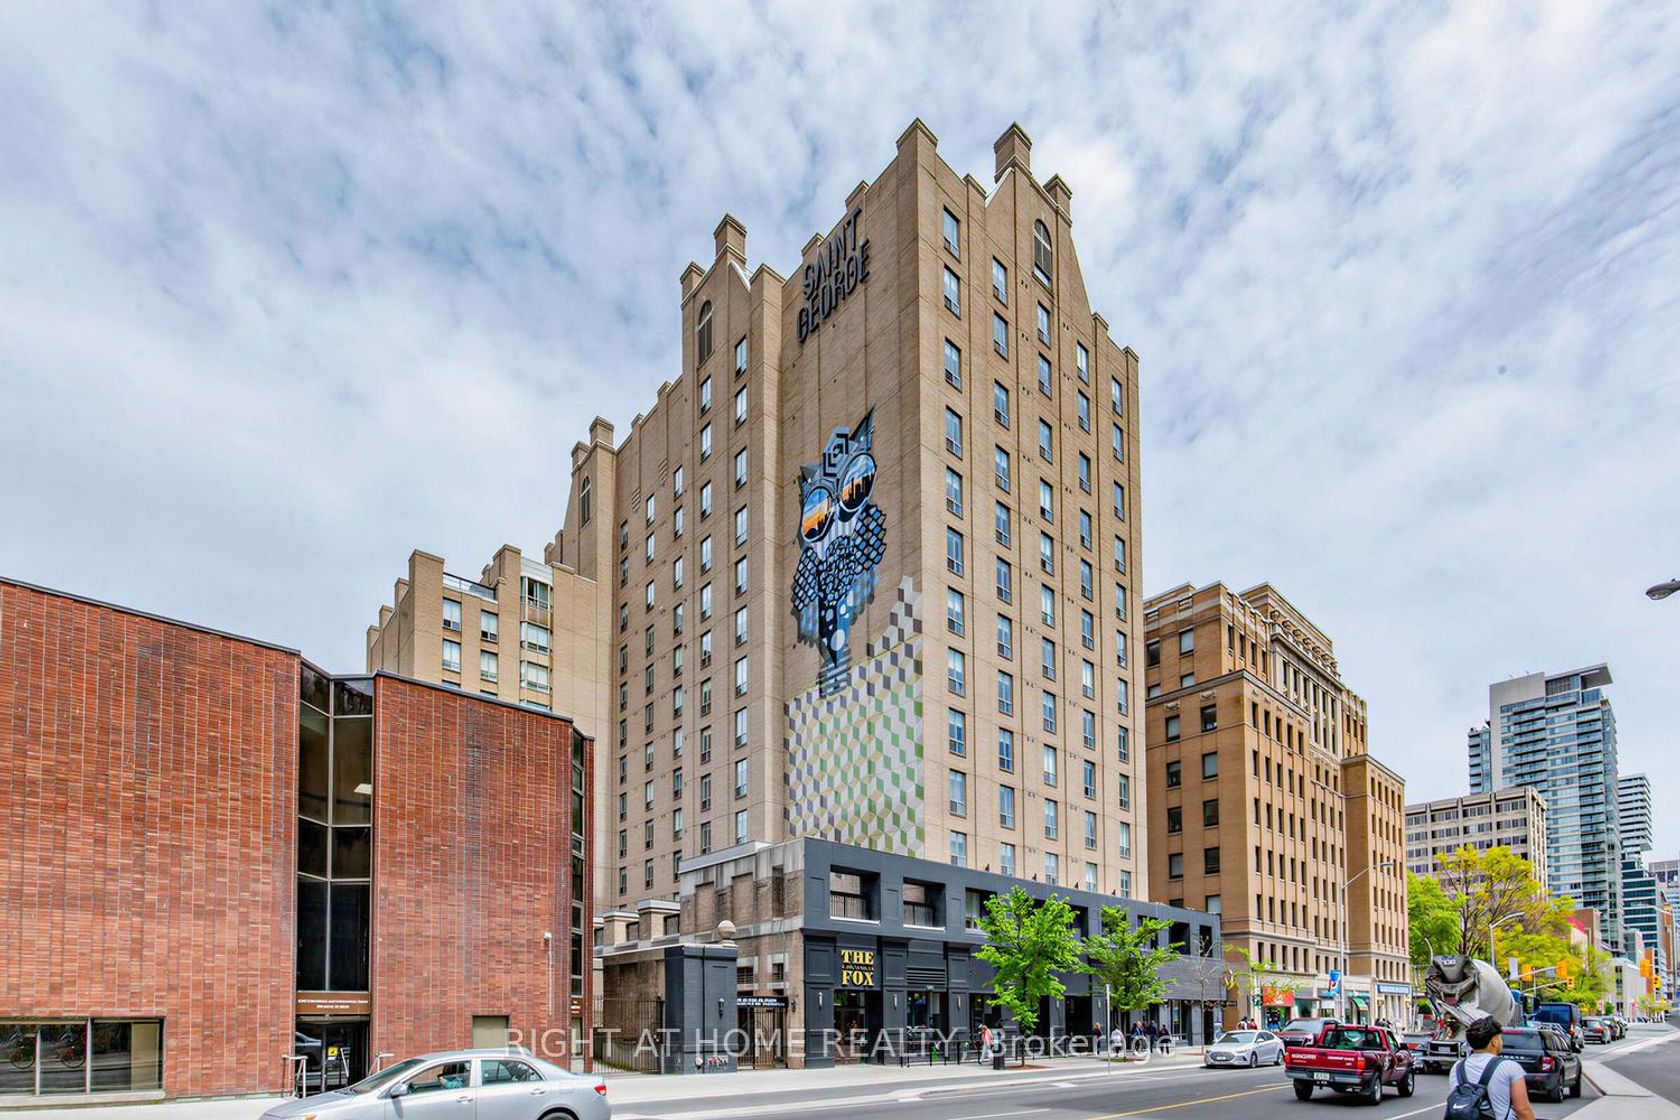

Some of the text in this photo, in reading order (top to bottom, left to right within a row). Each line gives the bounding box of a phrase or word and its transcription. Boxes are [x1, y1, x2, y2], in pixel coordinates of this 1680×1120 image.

[803, 207, 862, 300] SAINT
[797, 238, 870, 343] GEORGE
[841, 949, 874, 964] THE
[841, 970, 875, 986] FOX
